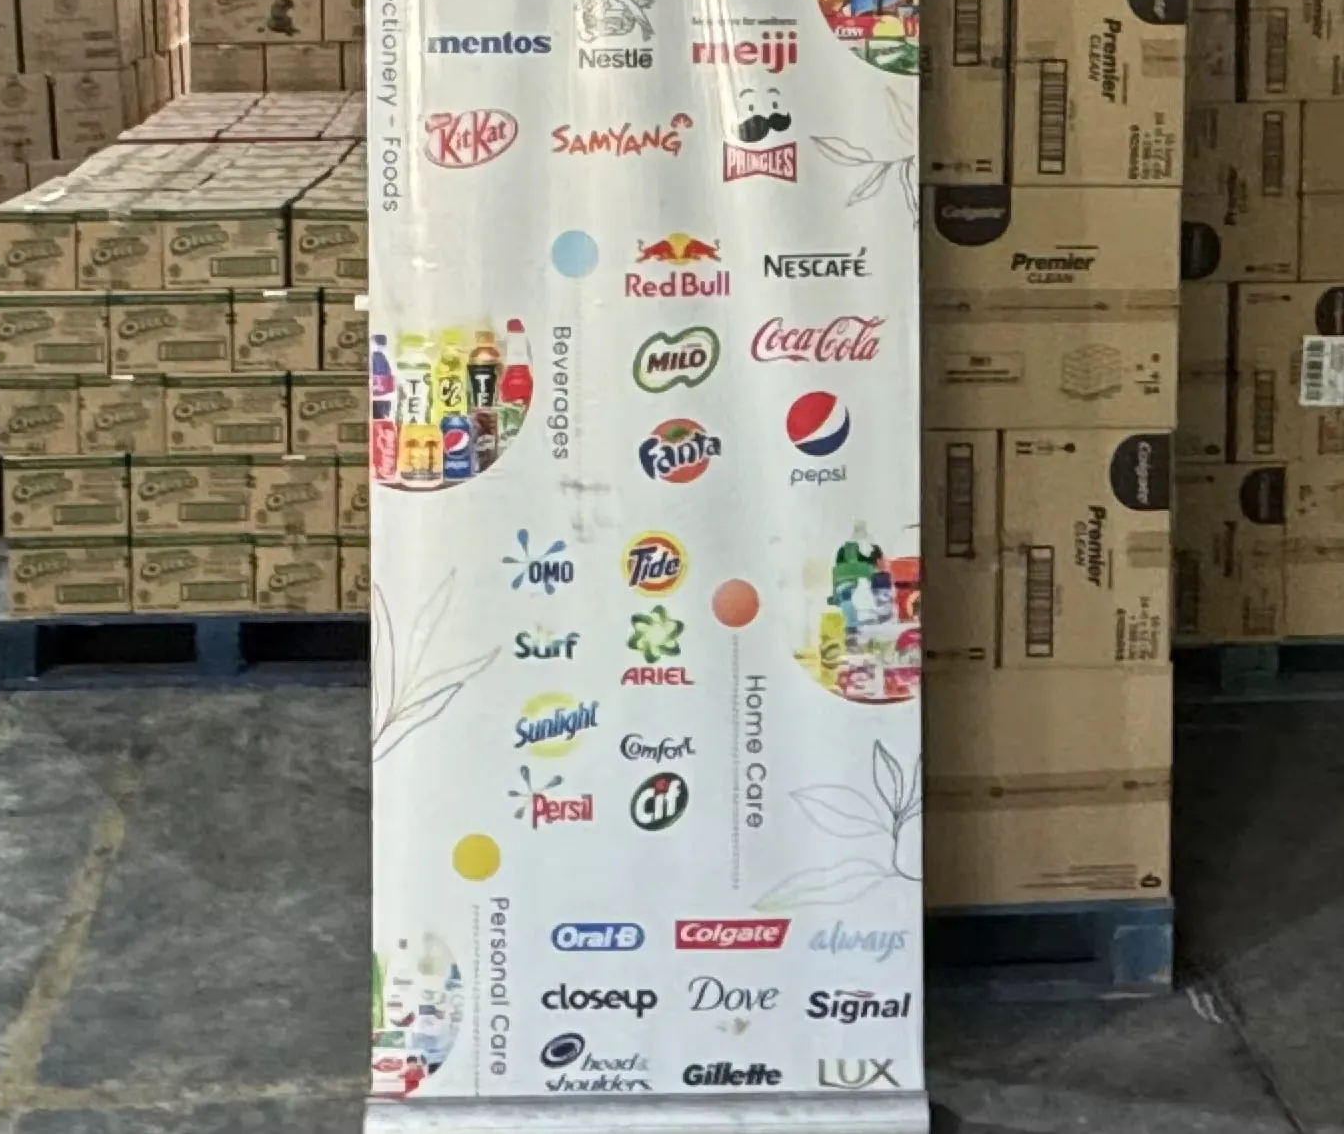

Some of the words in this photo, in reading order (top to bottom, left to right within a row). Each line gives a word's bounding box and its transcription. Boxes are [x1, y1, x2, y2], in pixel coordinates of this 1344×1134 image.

[427, 30, 552, 54] mentos
[691, 30, 798, 74] meiji
[1101, 17, 1122, 104] Premier
[551, 121, 684, 158] SAMYANG
[382, 136, 402, 212] Foods
[725, 146, 795, 180] PRINGLES
[1010, 252, 1096, 272] Premier
[624, 271, 677, 298] Red
[681, 270, 731, 298] Bull
[750, 315, 886, 364] Coca-Cola
[646, 348, 708, 374] MILO
[547, 326, 572, 460] Beverages
[639, 431, 722, 481] Fanta
[789, 465, 847, 486] pepsi
[1087, 504, 1107, 587] Premier
[528, 561, 575, 585] OMO
[627, 545, 681, 588] Tide
[514, 631, 581, 660] Surf
[620, 667, 696, 686] ARIEL
[513, 700, 600, 750] Sunlight
[744, 674, 767, 754] Home
[619, 732, 697, 764] Comfort
[531, 793, 594, 829] Persil
[635, 777, 685, 825] Cif
[746, 762, 767, 829] Care
[489, 896, 511, 1006] Personal
[555, 926, 640, 950] Oral-B
[679, 922, 782, 948] Colgate
[808, 920, 911, 963] always
[540, 982, 659, 1019] closeup
[687, 975, 781, 1012] Dove
[804, 990, 912, 1024] Signal
[490, 1014, 511, 1077] Care
[682, 1062, 783, 1087] Gillette
[817, 1057, 902, 1090] LUX
